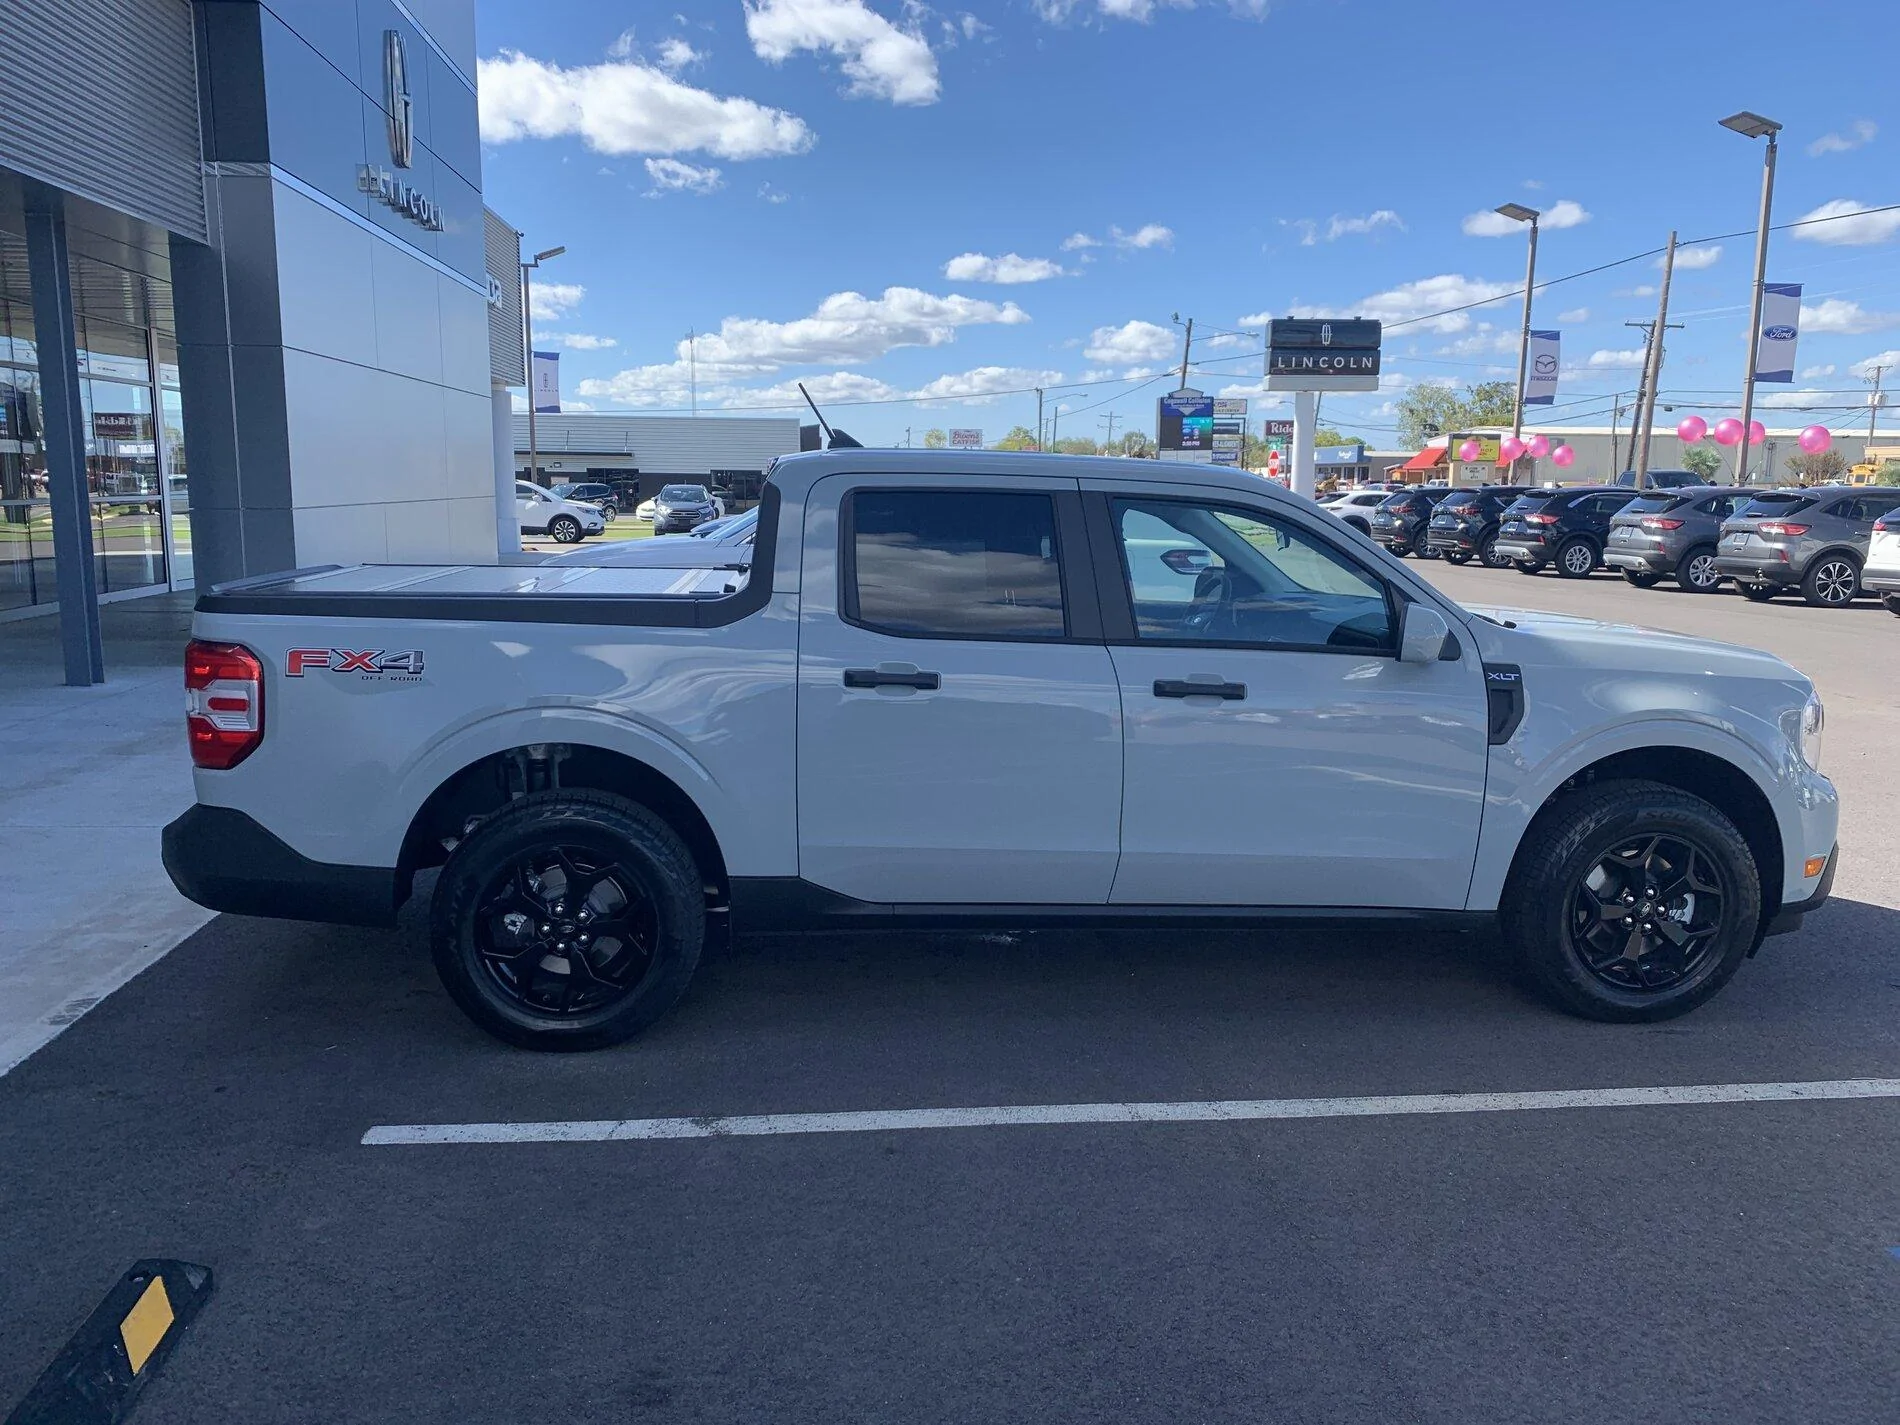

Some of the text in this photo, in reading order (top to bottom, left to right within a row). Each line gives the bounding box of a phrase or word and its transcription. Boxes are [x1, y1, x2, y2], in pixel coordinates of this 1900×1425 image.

[379, 164, 445, 232] LINCOLN
[1769, 327, 1793, 338] Ford
[1278, 356, 1372, 368] LINCOLN
[285, 647, 424, 677] FX4
[1488, 672, 1519, 680] XLT
